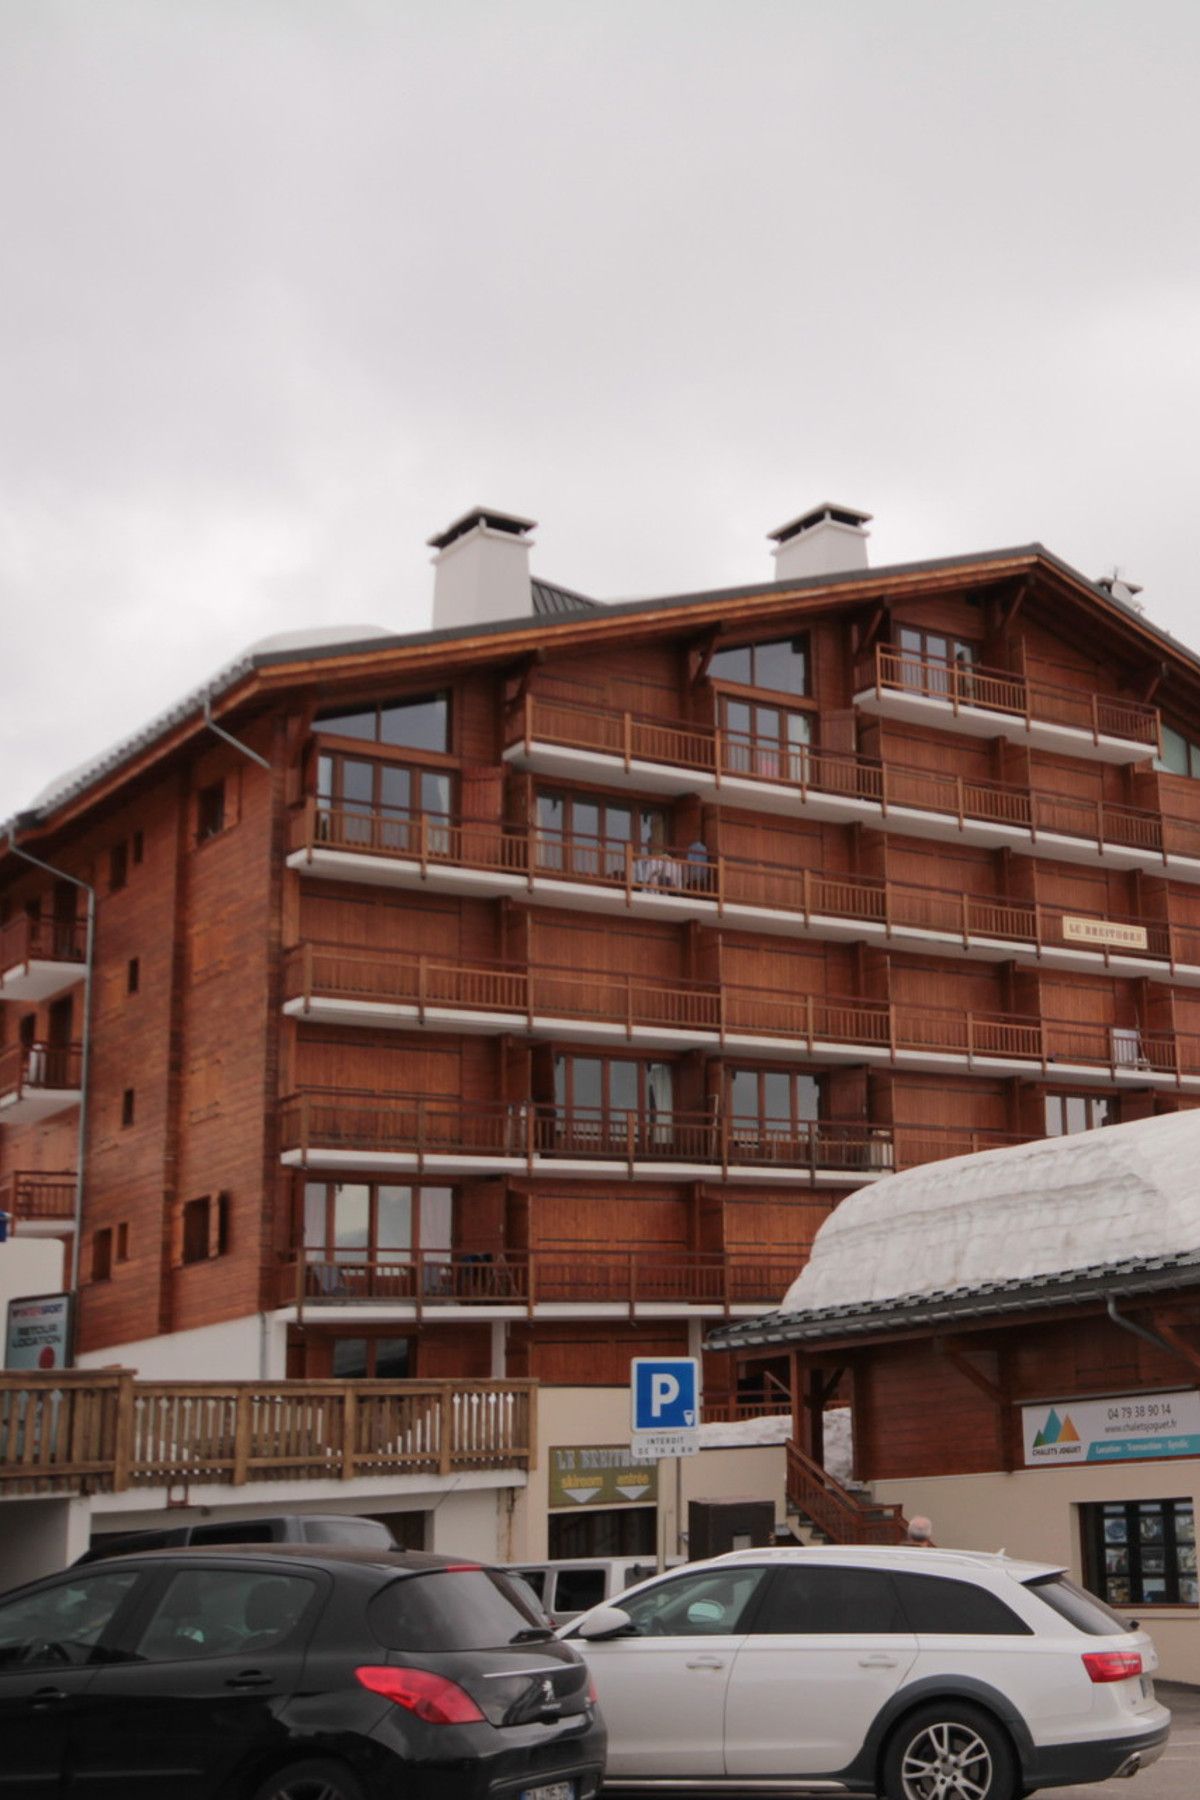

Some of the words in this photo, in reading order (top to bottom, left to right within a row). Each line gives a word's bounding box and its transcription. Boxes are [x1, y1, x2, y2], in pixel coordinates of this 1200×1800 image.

[651, 1373, 680, 1418] P
[1107, 1407, 1119, 1420] 04
[1121, 1406, 1133, 1419] 79
[1134, 1405, 1146, 1417] 38
[1148, 1404, 1159, 1417] 90
[647, 1436, 684, 1445] INTERDIT
[1032, 1447, 1058, 1457] CHALETS
